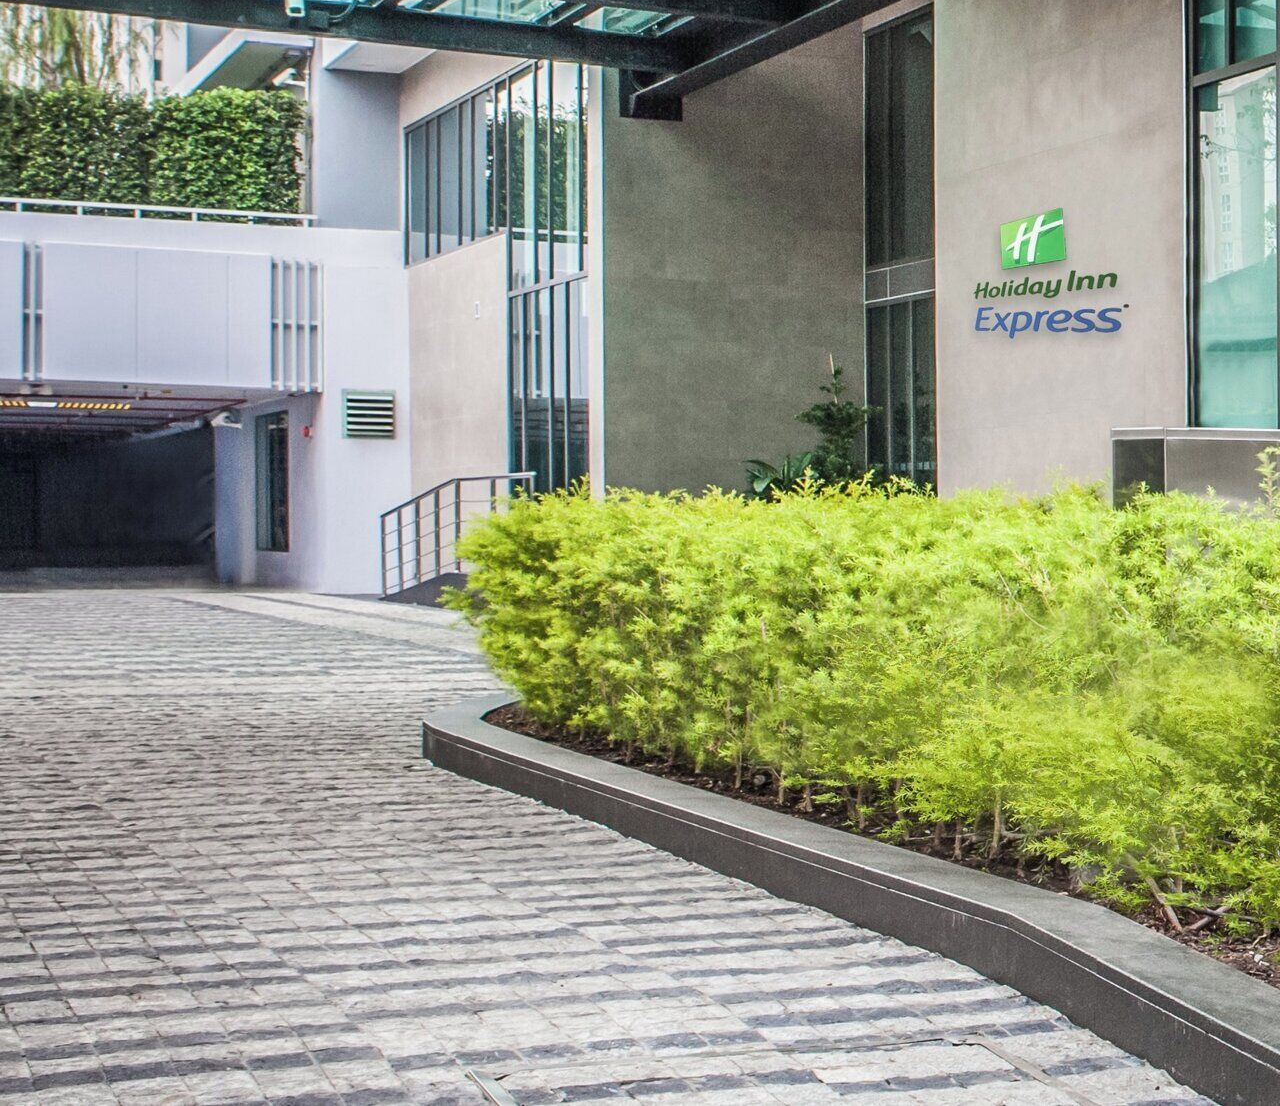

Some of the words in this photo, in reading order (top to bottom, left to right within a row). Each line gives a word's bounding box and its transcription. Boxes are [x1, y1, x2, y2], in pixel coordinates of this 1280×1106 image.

[974, 276, 1063, 299] Holiday
[1067, 270, 1118, 292] Inn
[974, 306, 1122, 339] Express
